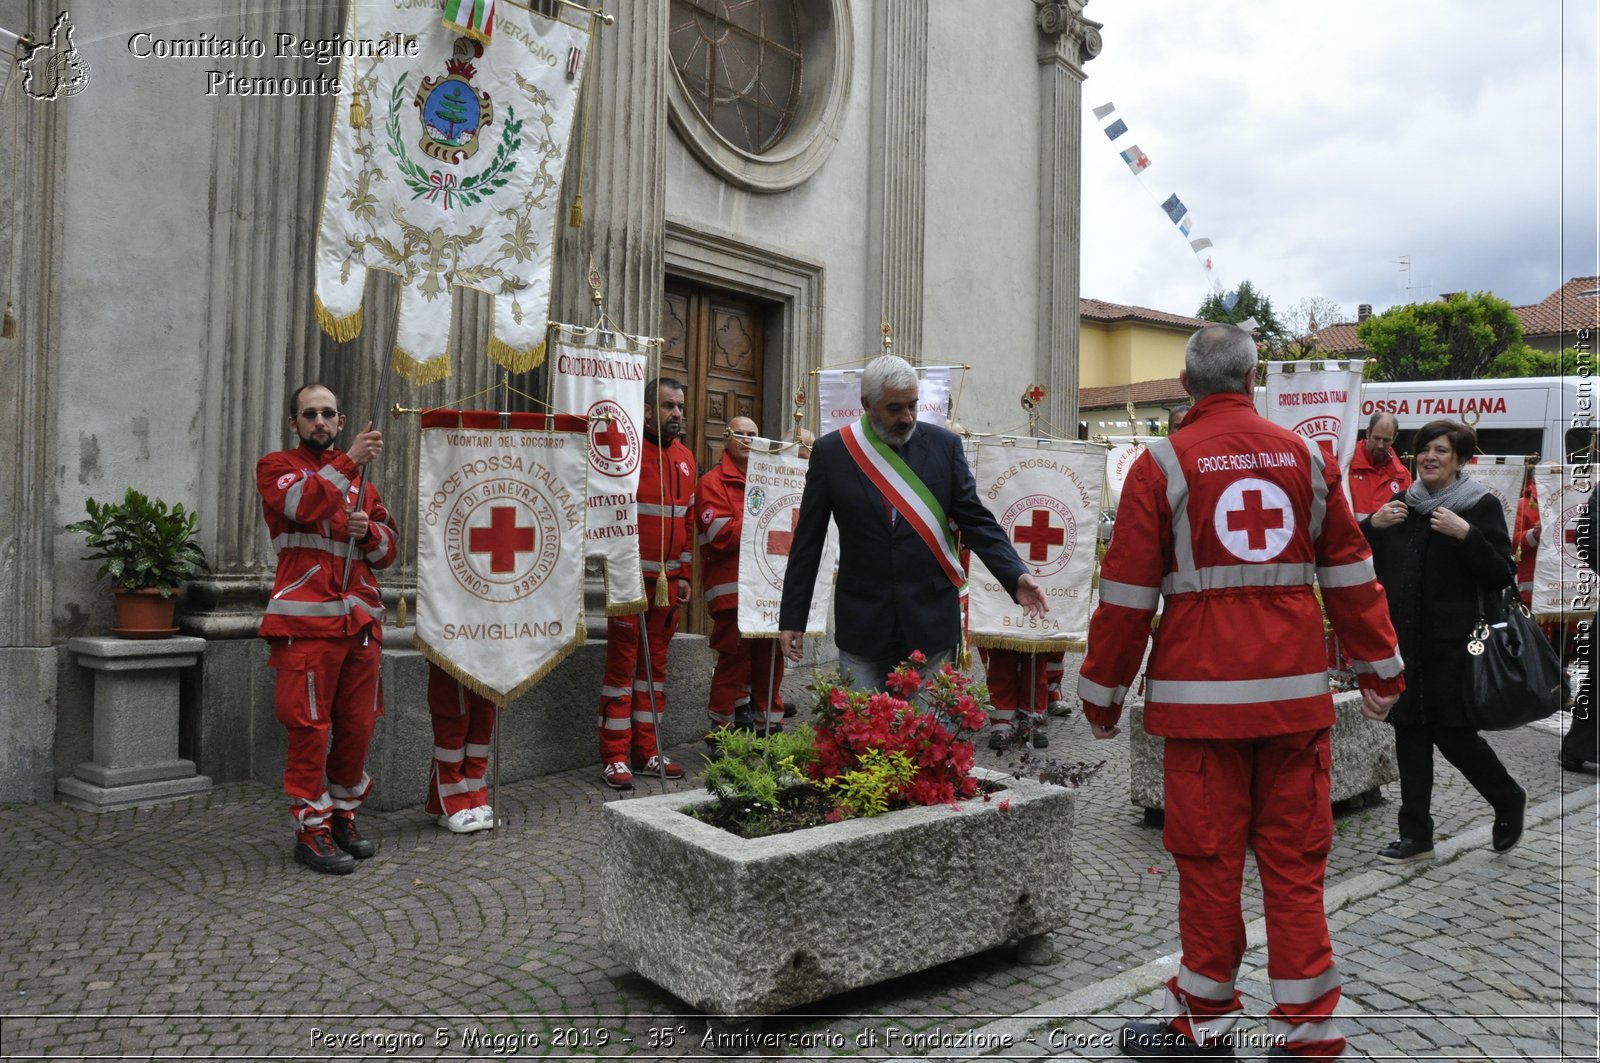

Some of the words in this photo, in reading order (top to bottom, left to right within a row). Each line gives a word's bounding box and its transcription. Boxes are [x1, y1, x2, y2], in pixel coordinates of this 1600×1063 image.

[1278, 392, 1300, 406] CROCE
[1302, 391, 1329, 405] ROSSA
[1361, 399, 1410, 415] OSSA
[1416, 397, 1507, 415] ITALIANA
[831, 407, 865, 418] CROCE
[497, 435, 516, 448] DEL
[520, 436, 565, 449] SOCCORSO
[1197, 455, 1230, 473] CROCE
[1229, 453, 1258, 470] ROSSA
[1258, 451, 1298, 468] ITALIANA
[748, 473, 780, 487] CROCE
[987, 465, 1019, 501] CROCE
[1019, 458, 1058, 471] ROSSA
[1059, 464, 1091, 509] ITALIANA
[424, 472, 462, 527] CROCE
[461, 455, 523, 479] ROSSA
[527, 461, 580, 531] ITALIANA
[463, 491, 479, 508] DI
[482, 481, 539, 507] GINEVRA
[537, 506, 552, 524] 22
[615, 509, 628, 521] DI
[1025, 497, 1060, 510] GINEVRA
[1059, 506, 1069, 518] 22
[1065, 517, 1075, 551] AGOSTO
[447, 508, 490, 596] CONVENZIONE
[537, 525, 558, 574] AGOSTO
[513, 572, 542, 596] 1864
[442, 620, 563, 641] SAVIGLIANO
[1002, 615, 1060, 630] BUSCA
